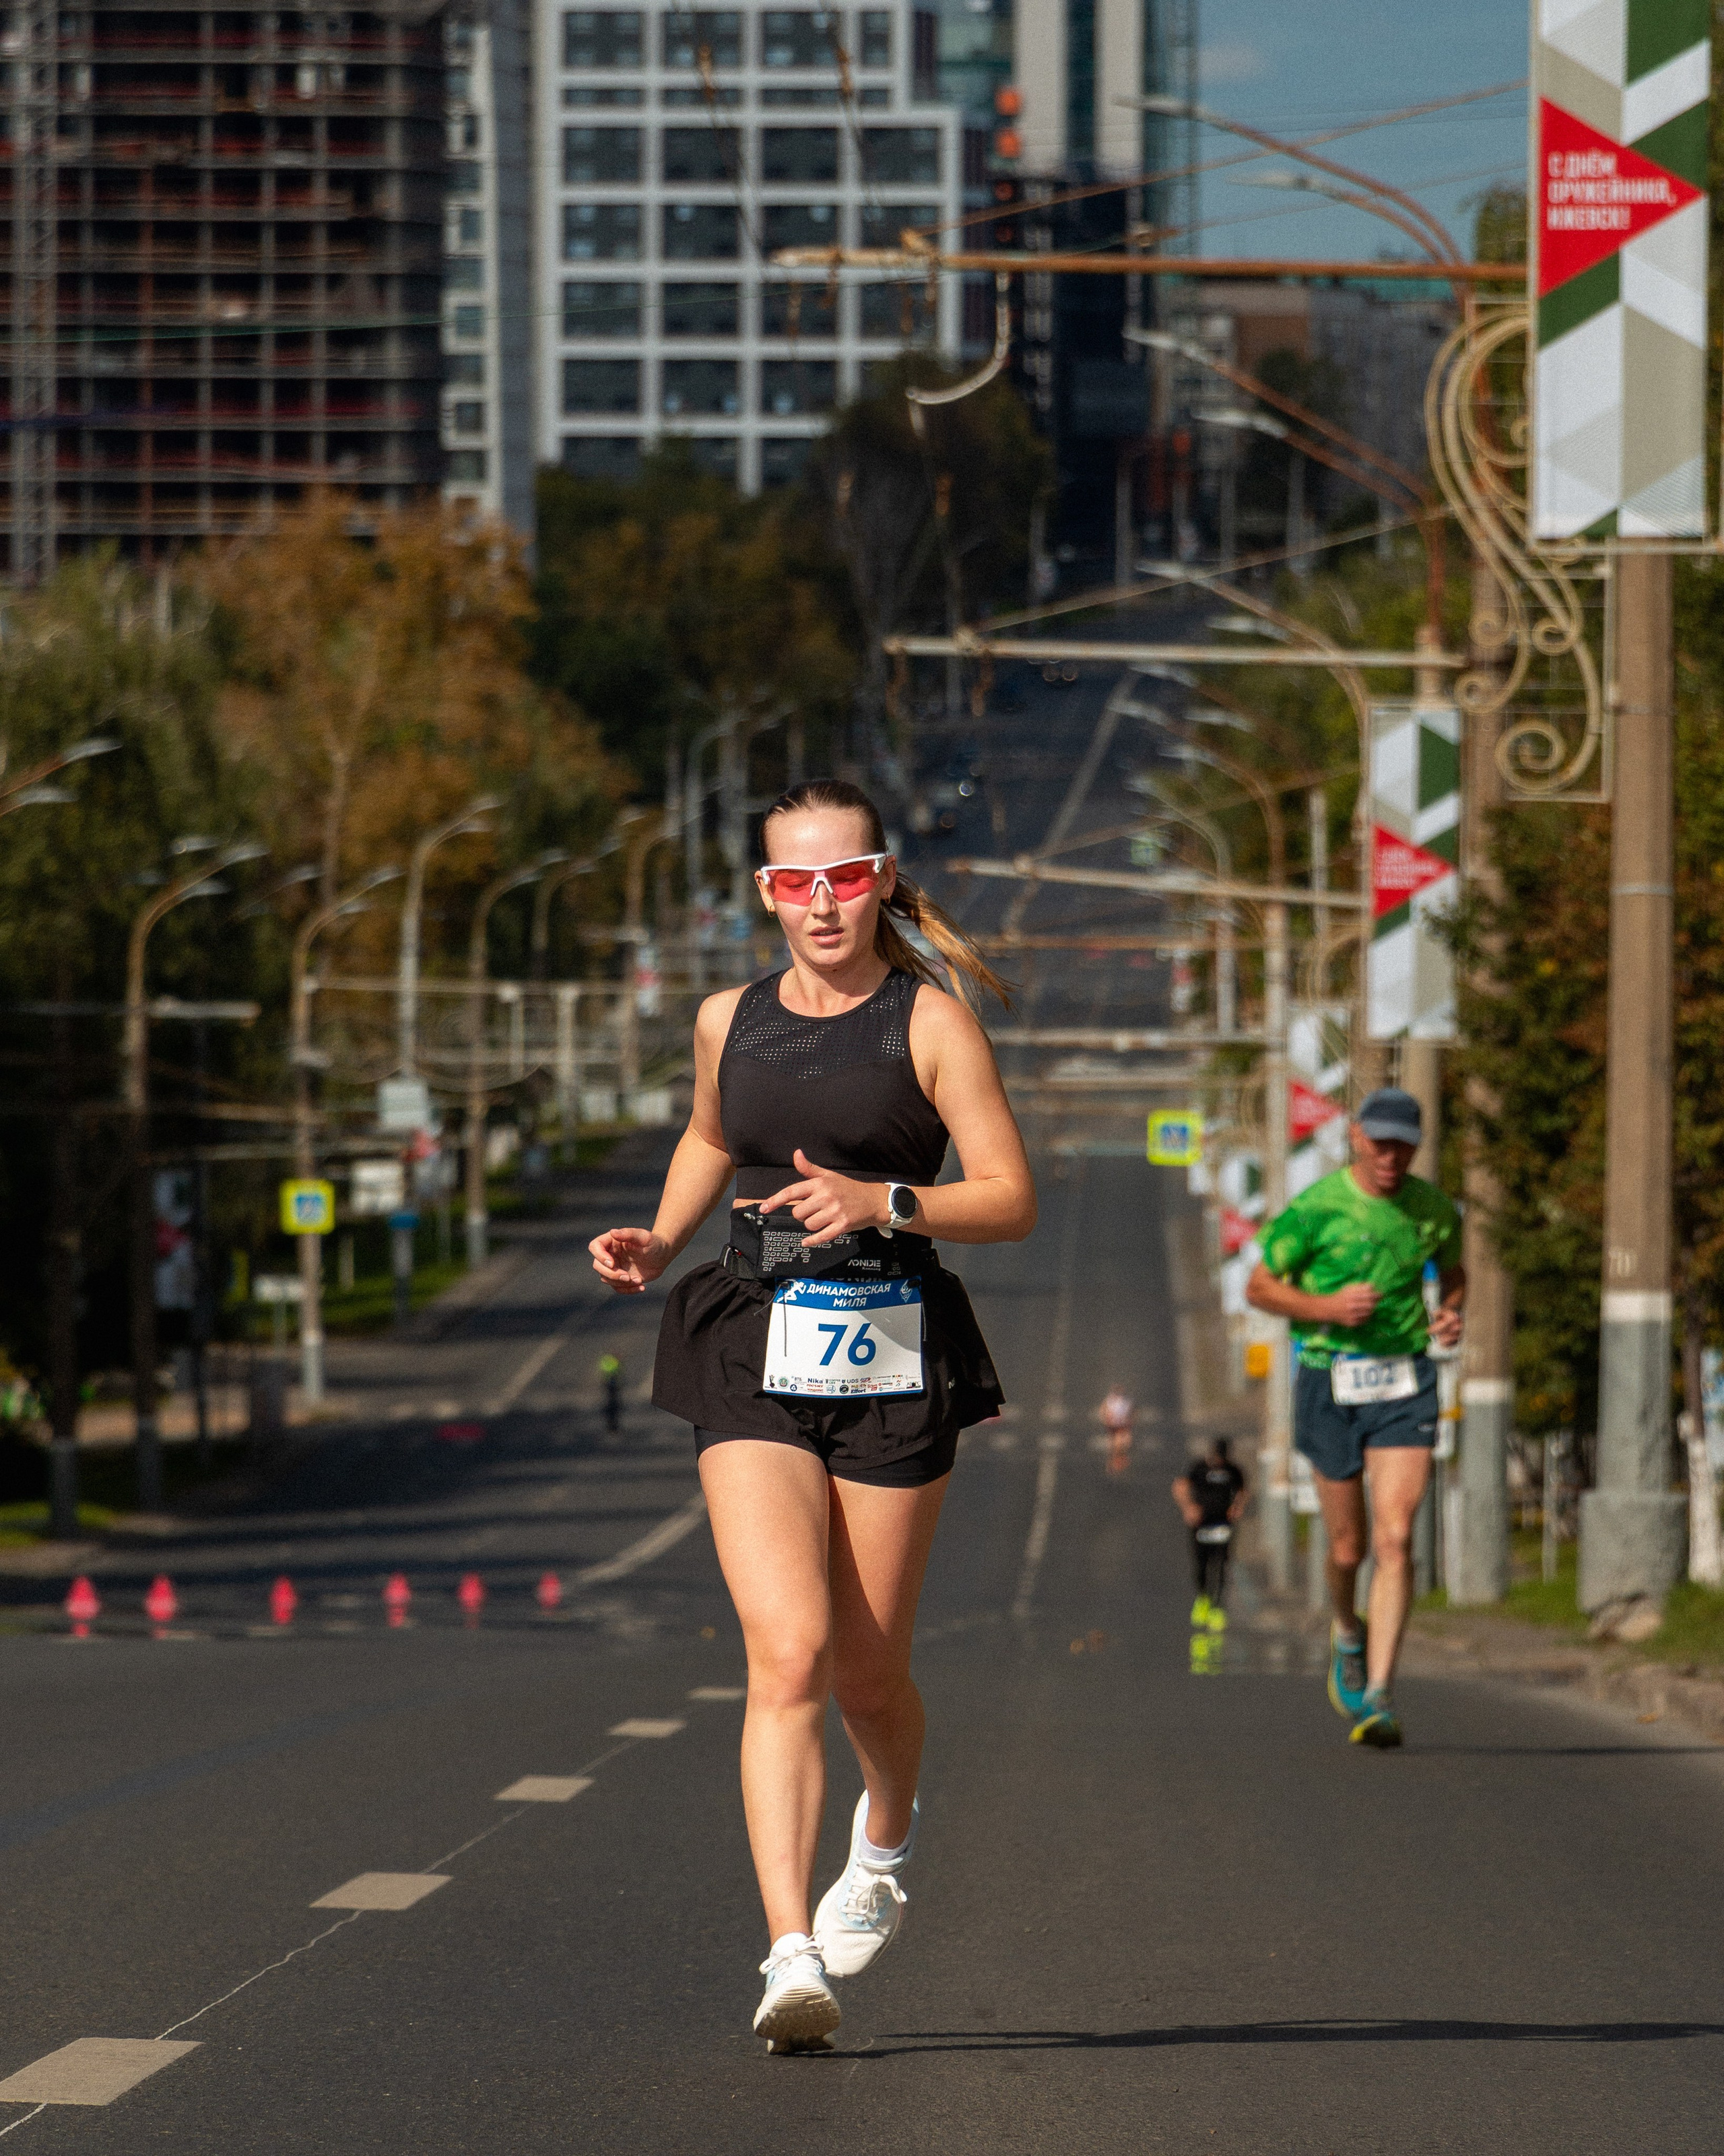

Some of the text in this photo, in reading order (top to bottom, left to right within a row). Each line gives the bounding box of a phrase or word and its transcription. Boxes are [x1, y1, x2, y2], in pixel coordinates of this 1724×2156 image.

[807, 1283, 892, 1297] ДИНАМОВСКАЯ
[833, 1297, 867, 1307] МИЛЯ
[818, 1322, 876, 1366] 76
